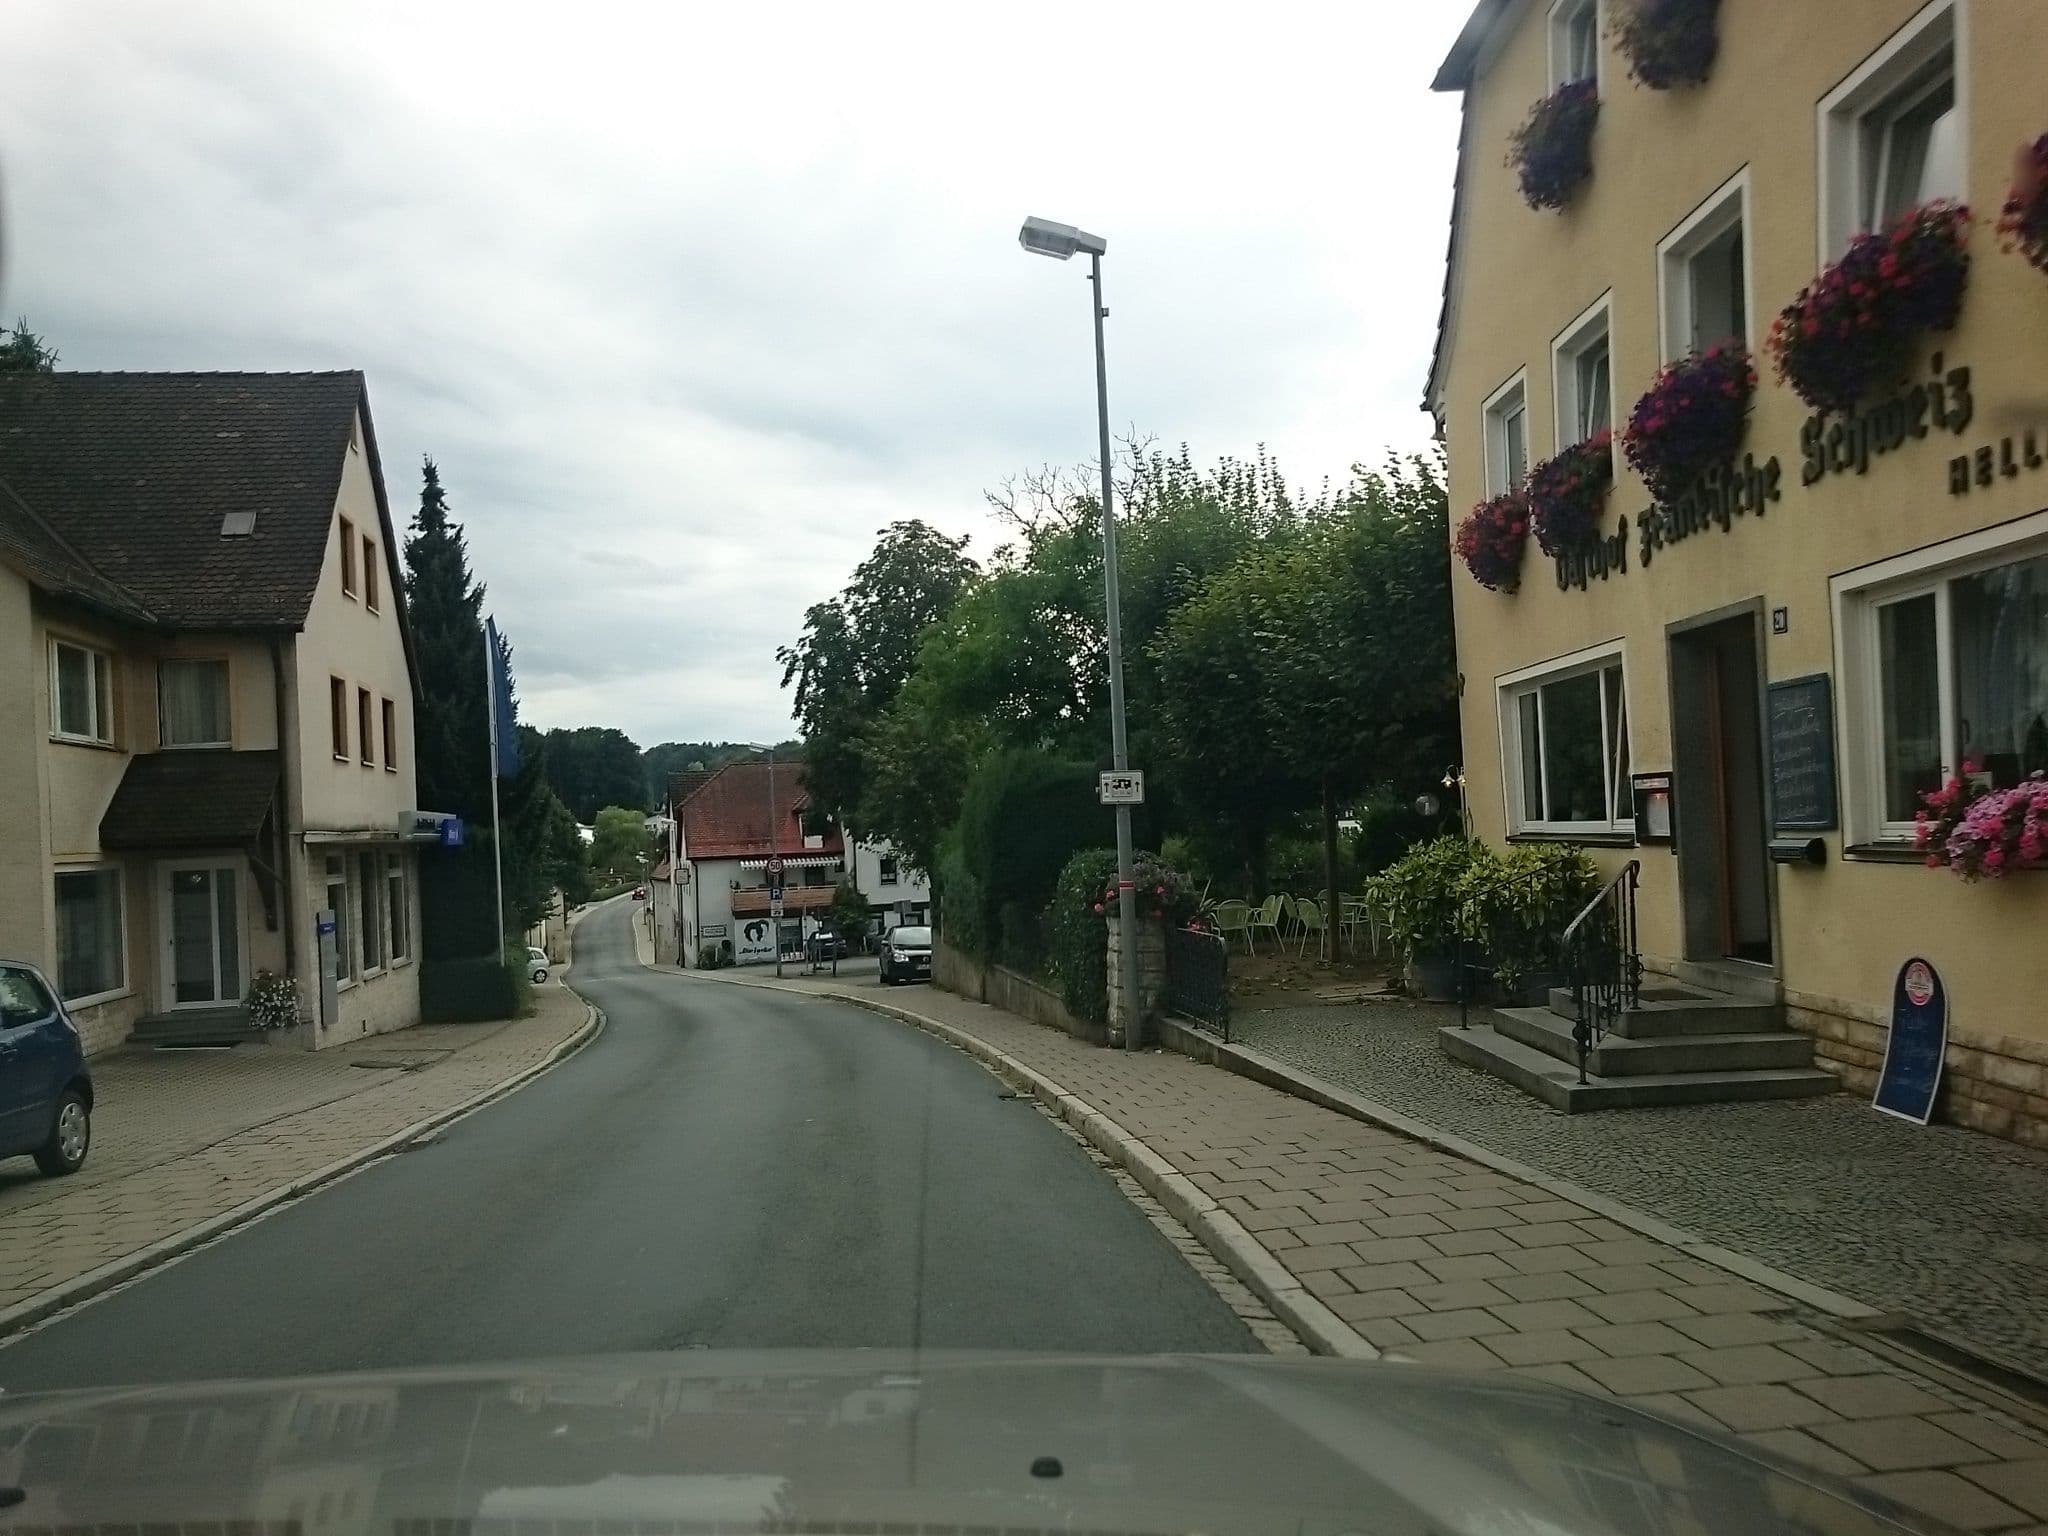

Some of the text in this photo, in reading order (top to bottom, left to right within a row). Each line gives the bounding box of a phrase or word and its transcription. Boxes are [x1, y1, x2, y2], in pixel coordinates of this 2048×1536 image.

[1948, 428, 2048, 495] HELL
[770, 861, 780, 870] 50
[772, 888, 780, 899] P
